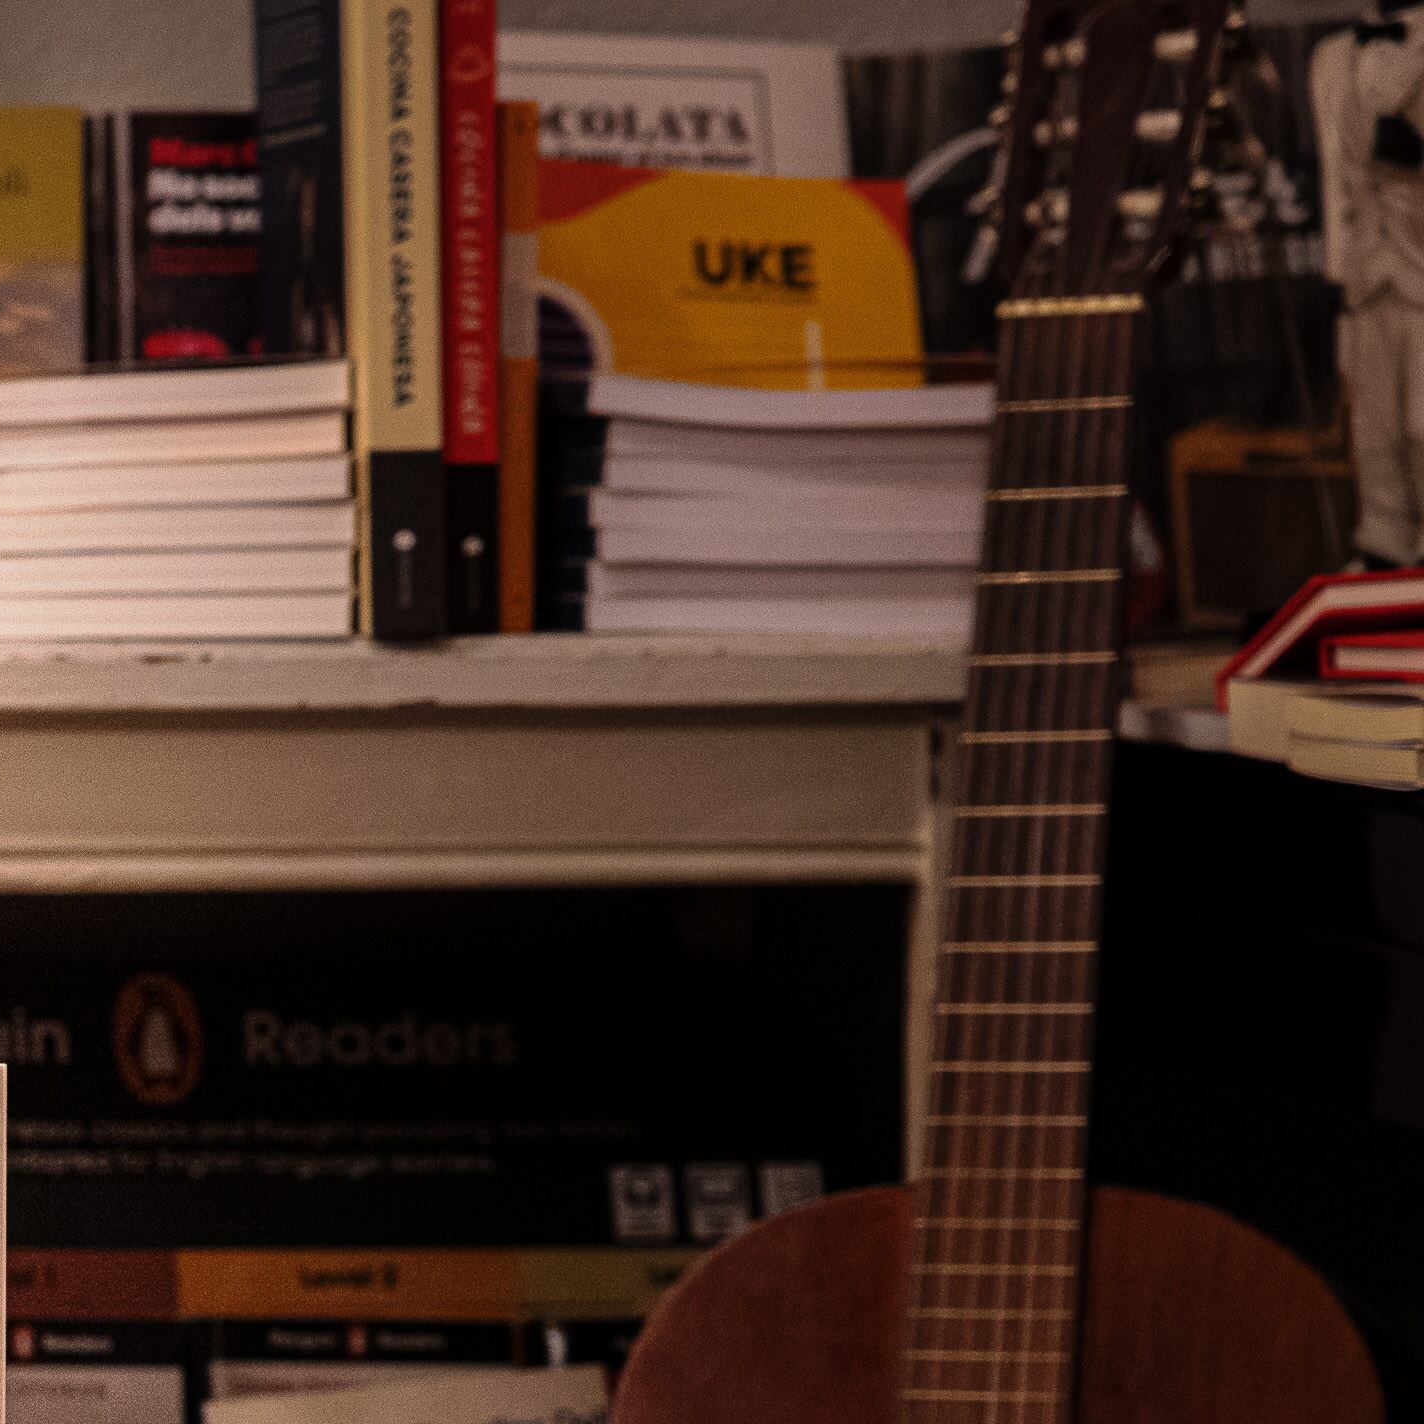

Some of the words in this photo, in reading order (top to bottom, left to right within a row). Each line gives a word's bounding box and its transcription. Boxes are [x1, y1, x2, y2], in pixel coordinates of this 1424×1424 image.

[387, 7, 412, 122] COCINA
[389, 129, 414, 245] CASERA
[692, 237, 816, 291] UKE
[392, 253, 417, 407] JAPONESA
[241, 1010, 519, 1068] Readers
